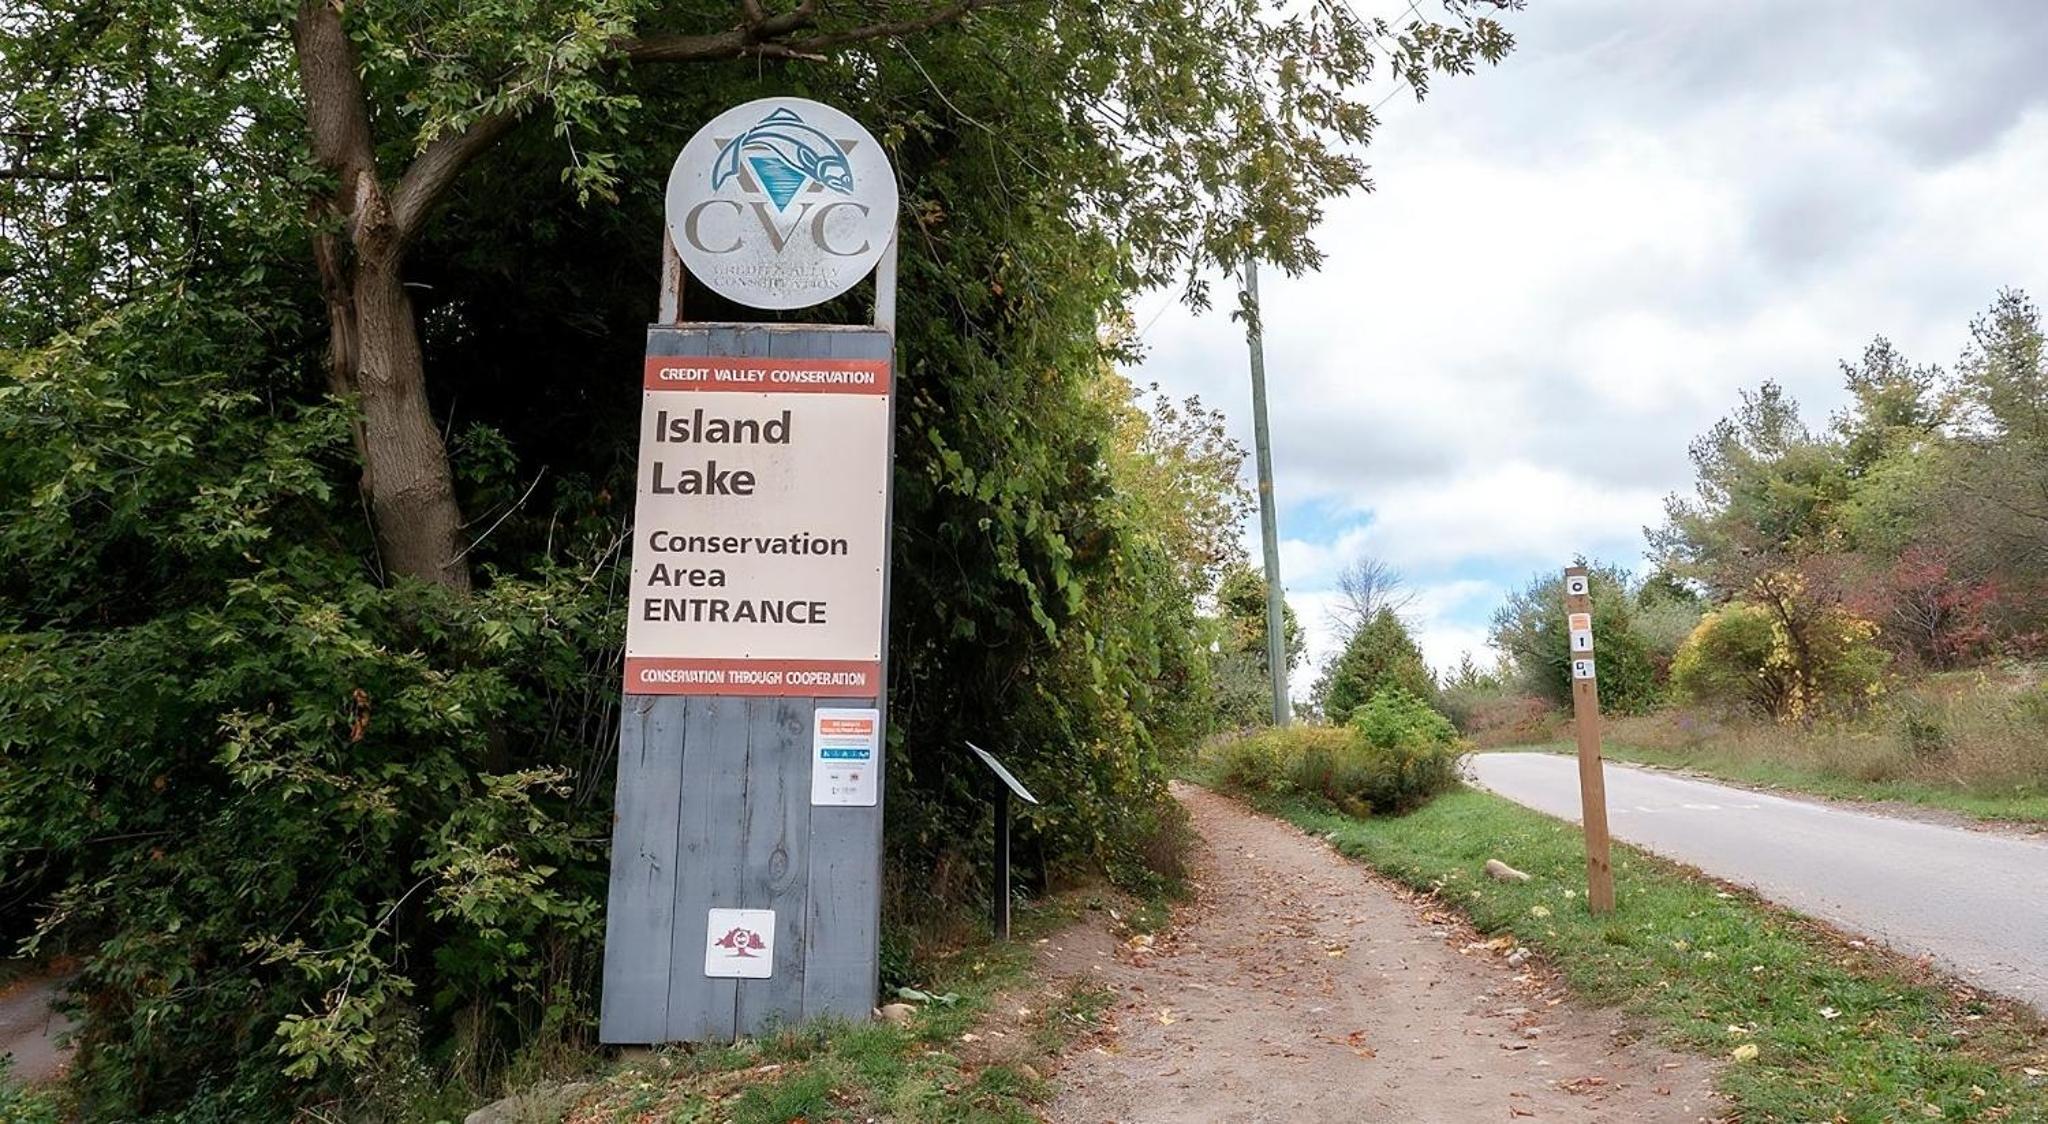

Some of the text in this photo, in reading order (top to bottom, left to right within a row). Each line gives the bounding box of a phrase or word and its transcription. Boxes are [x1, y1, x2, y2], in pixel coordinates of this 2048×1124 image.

[685, 200, 870, 256] CVC
[660, 368, 875, 384] CREDIT VALLEY CONSERVATION
[656, 409, 791, 444] Island
[652, 461, 755, 495] Lake
[650, 531, 848, 555] Conservation
[647, 563, 726, 586] Area
[643, 598, 827, 624] ENTRANCE
[640, 669, 866, 686] CONSERVATION THROUGH COOPERATION
